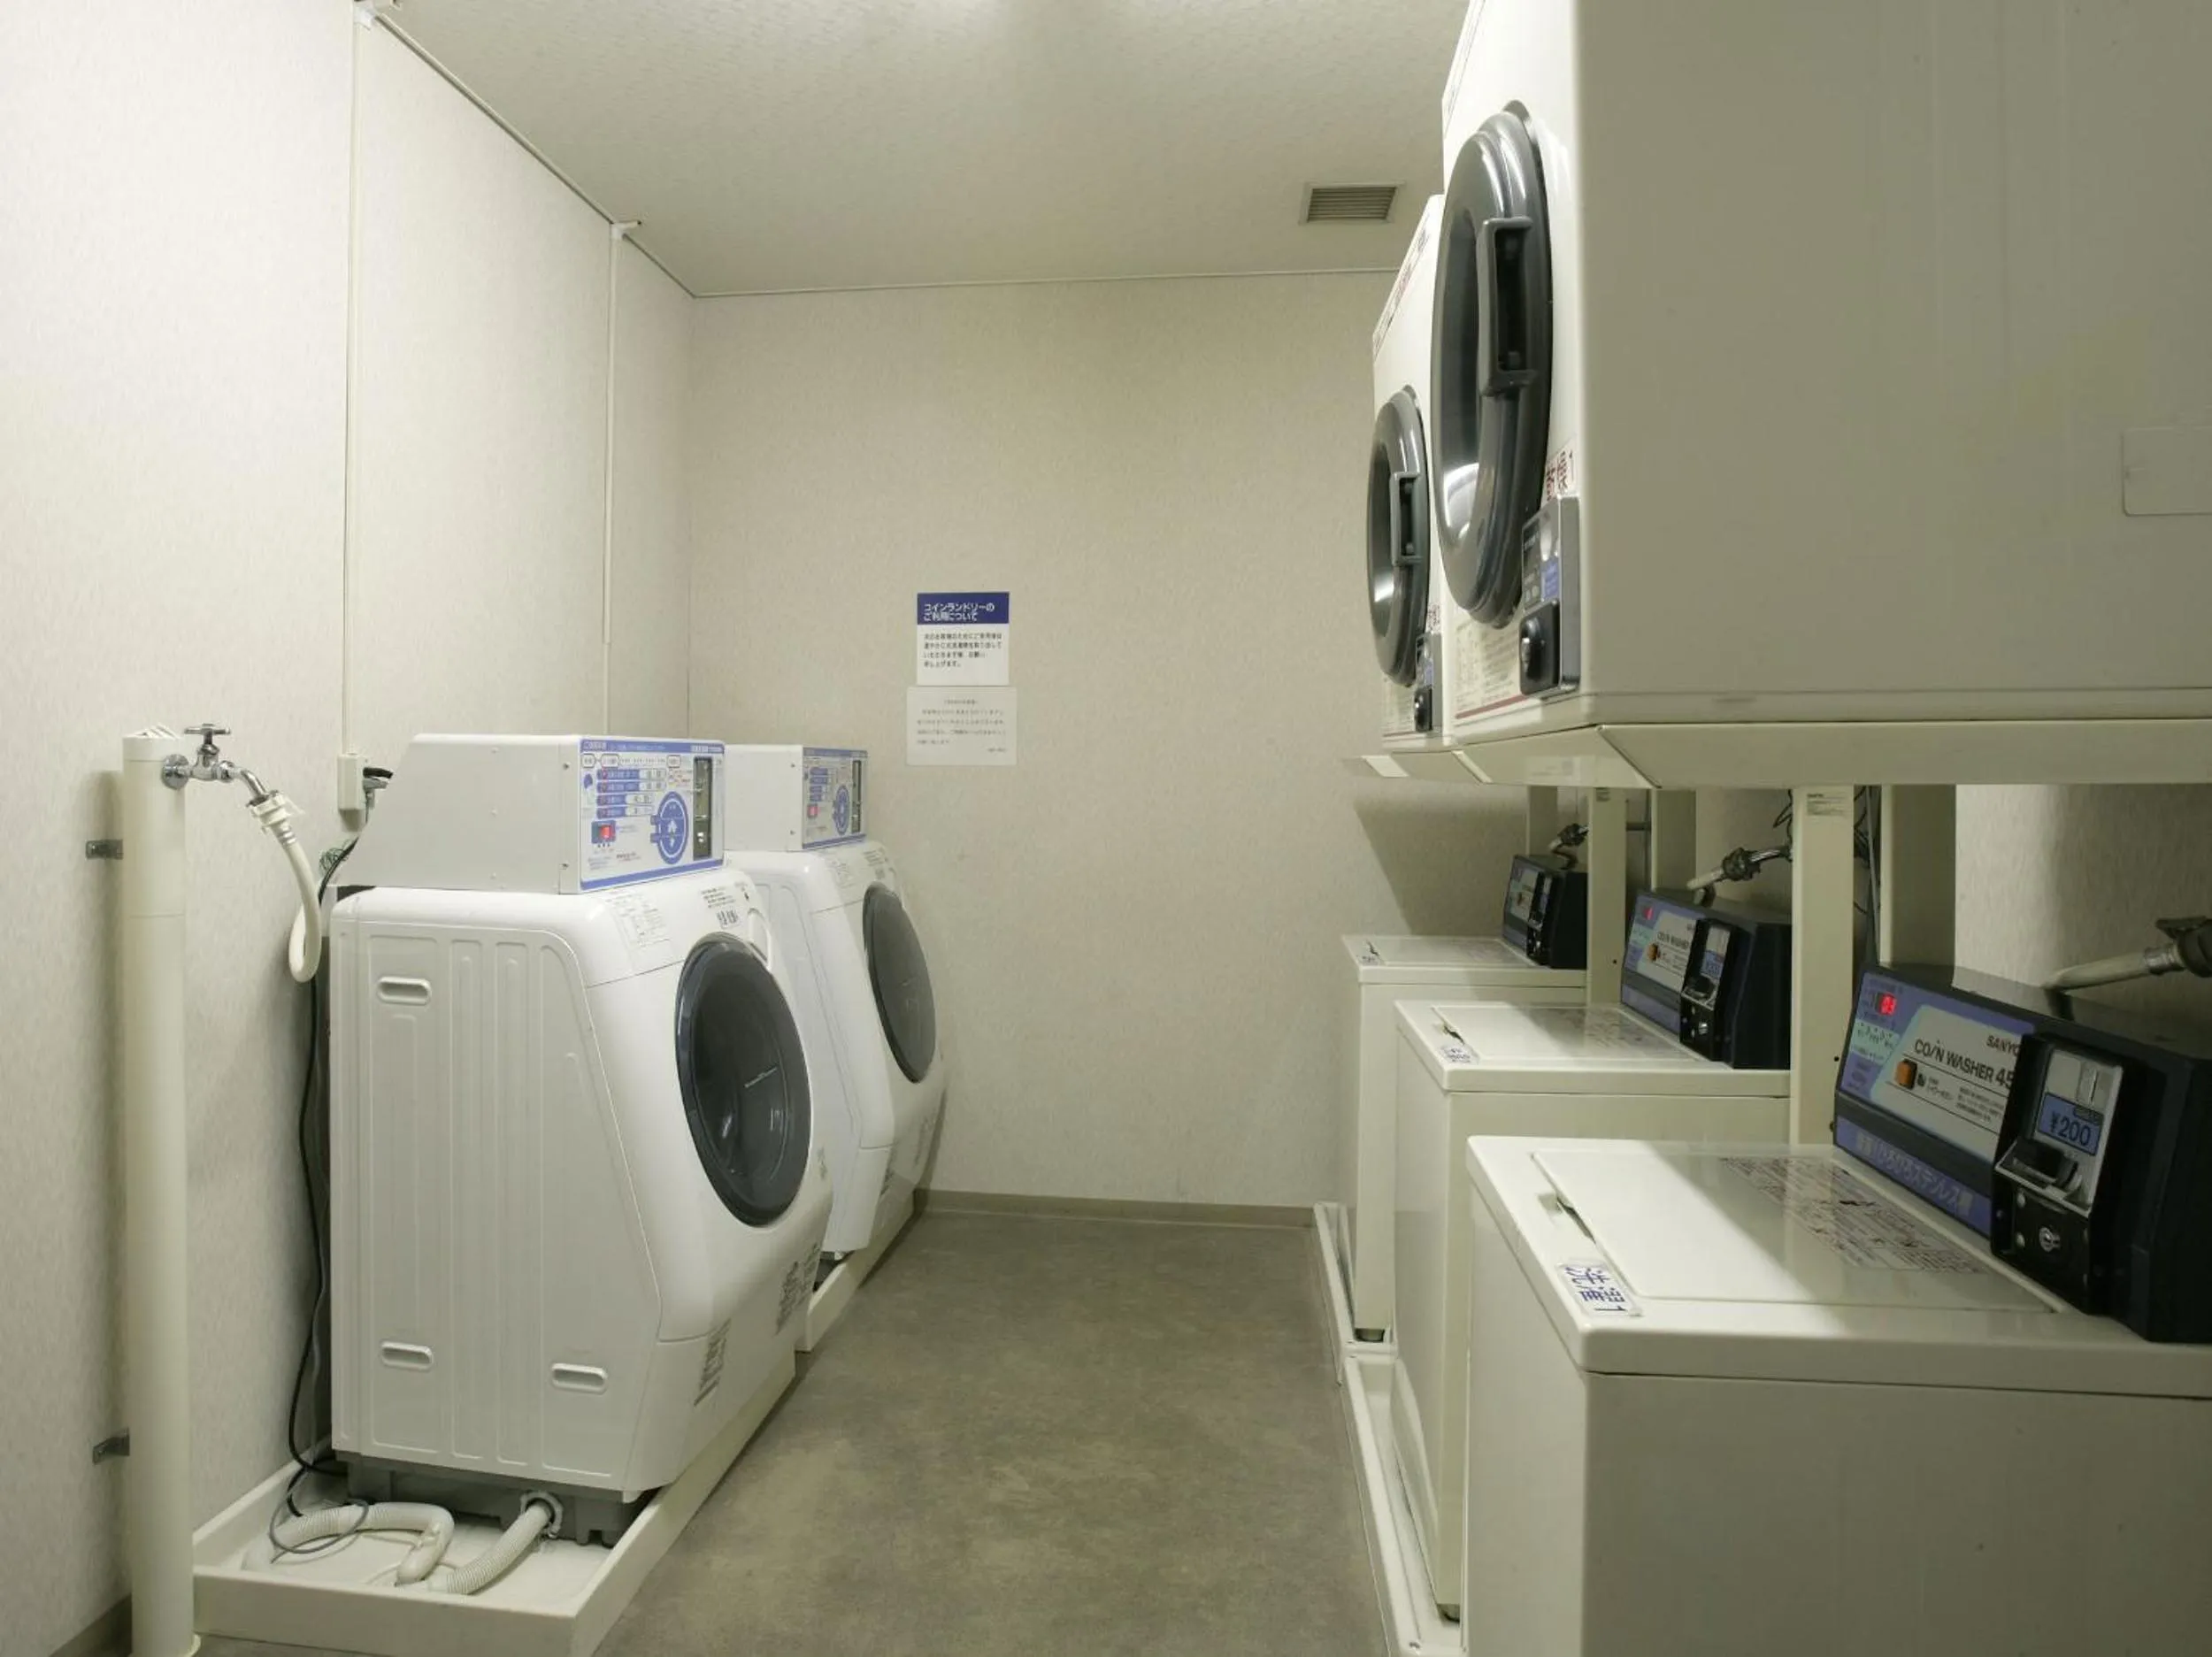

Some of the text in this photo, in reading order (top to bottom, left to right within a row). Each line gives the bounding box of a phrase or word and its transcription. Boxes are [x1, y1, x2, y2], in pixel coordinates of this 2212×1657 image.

[924, 602, 995, 612] コインランドリーの
[924, 611, 977, 621] ご利用について
[1947, 1052, 1993, 1082] WASHER
[2050, 1110, 2092, 1147] ¥200
